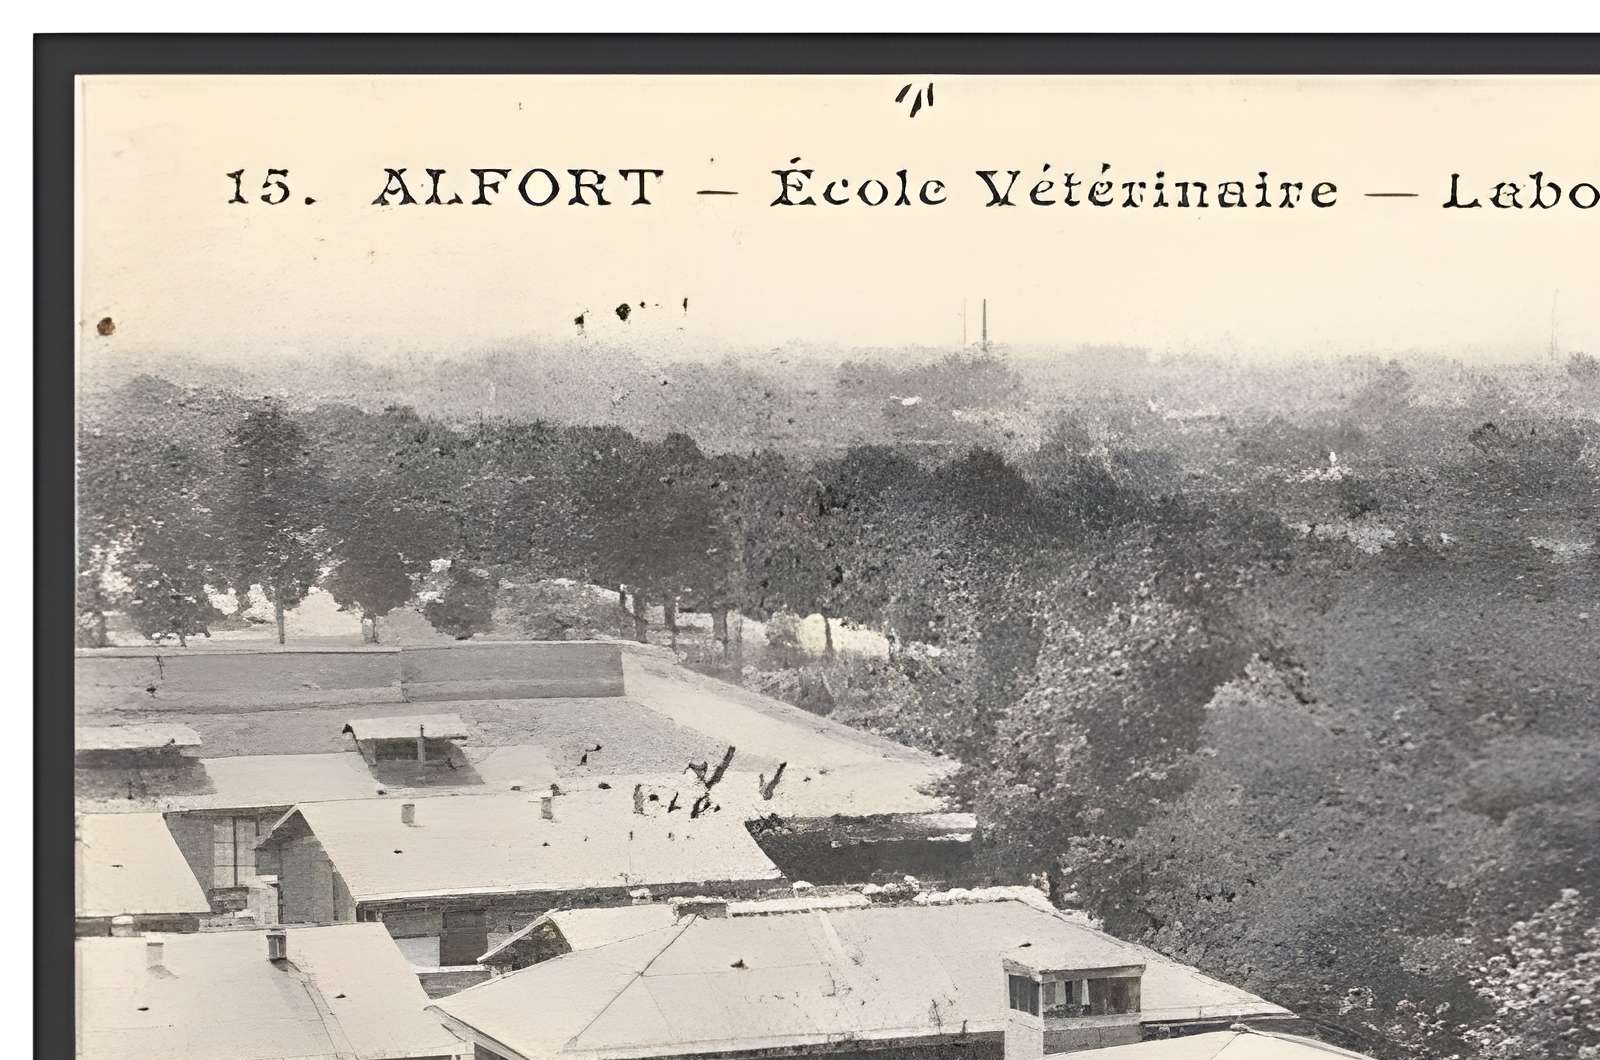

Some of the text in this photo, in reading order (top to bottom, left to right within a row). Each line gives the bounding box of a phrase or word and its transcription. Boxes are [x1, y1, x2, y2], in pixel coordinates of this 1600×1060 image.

[226, 168, 316, 206] 15.
[371, 167, 664, 207] ALFORT
[769, 156, 947, 207] École
[975, 162, 1338, 209] Vétérinaire
